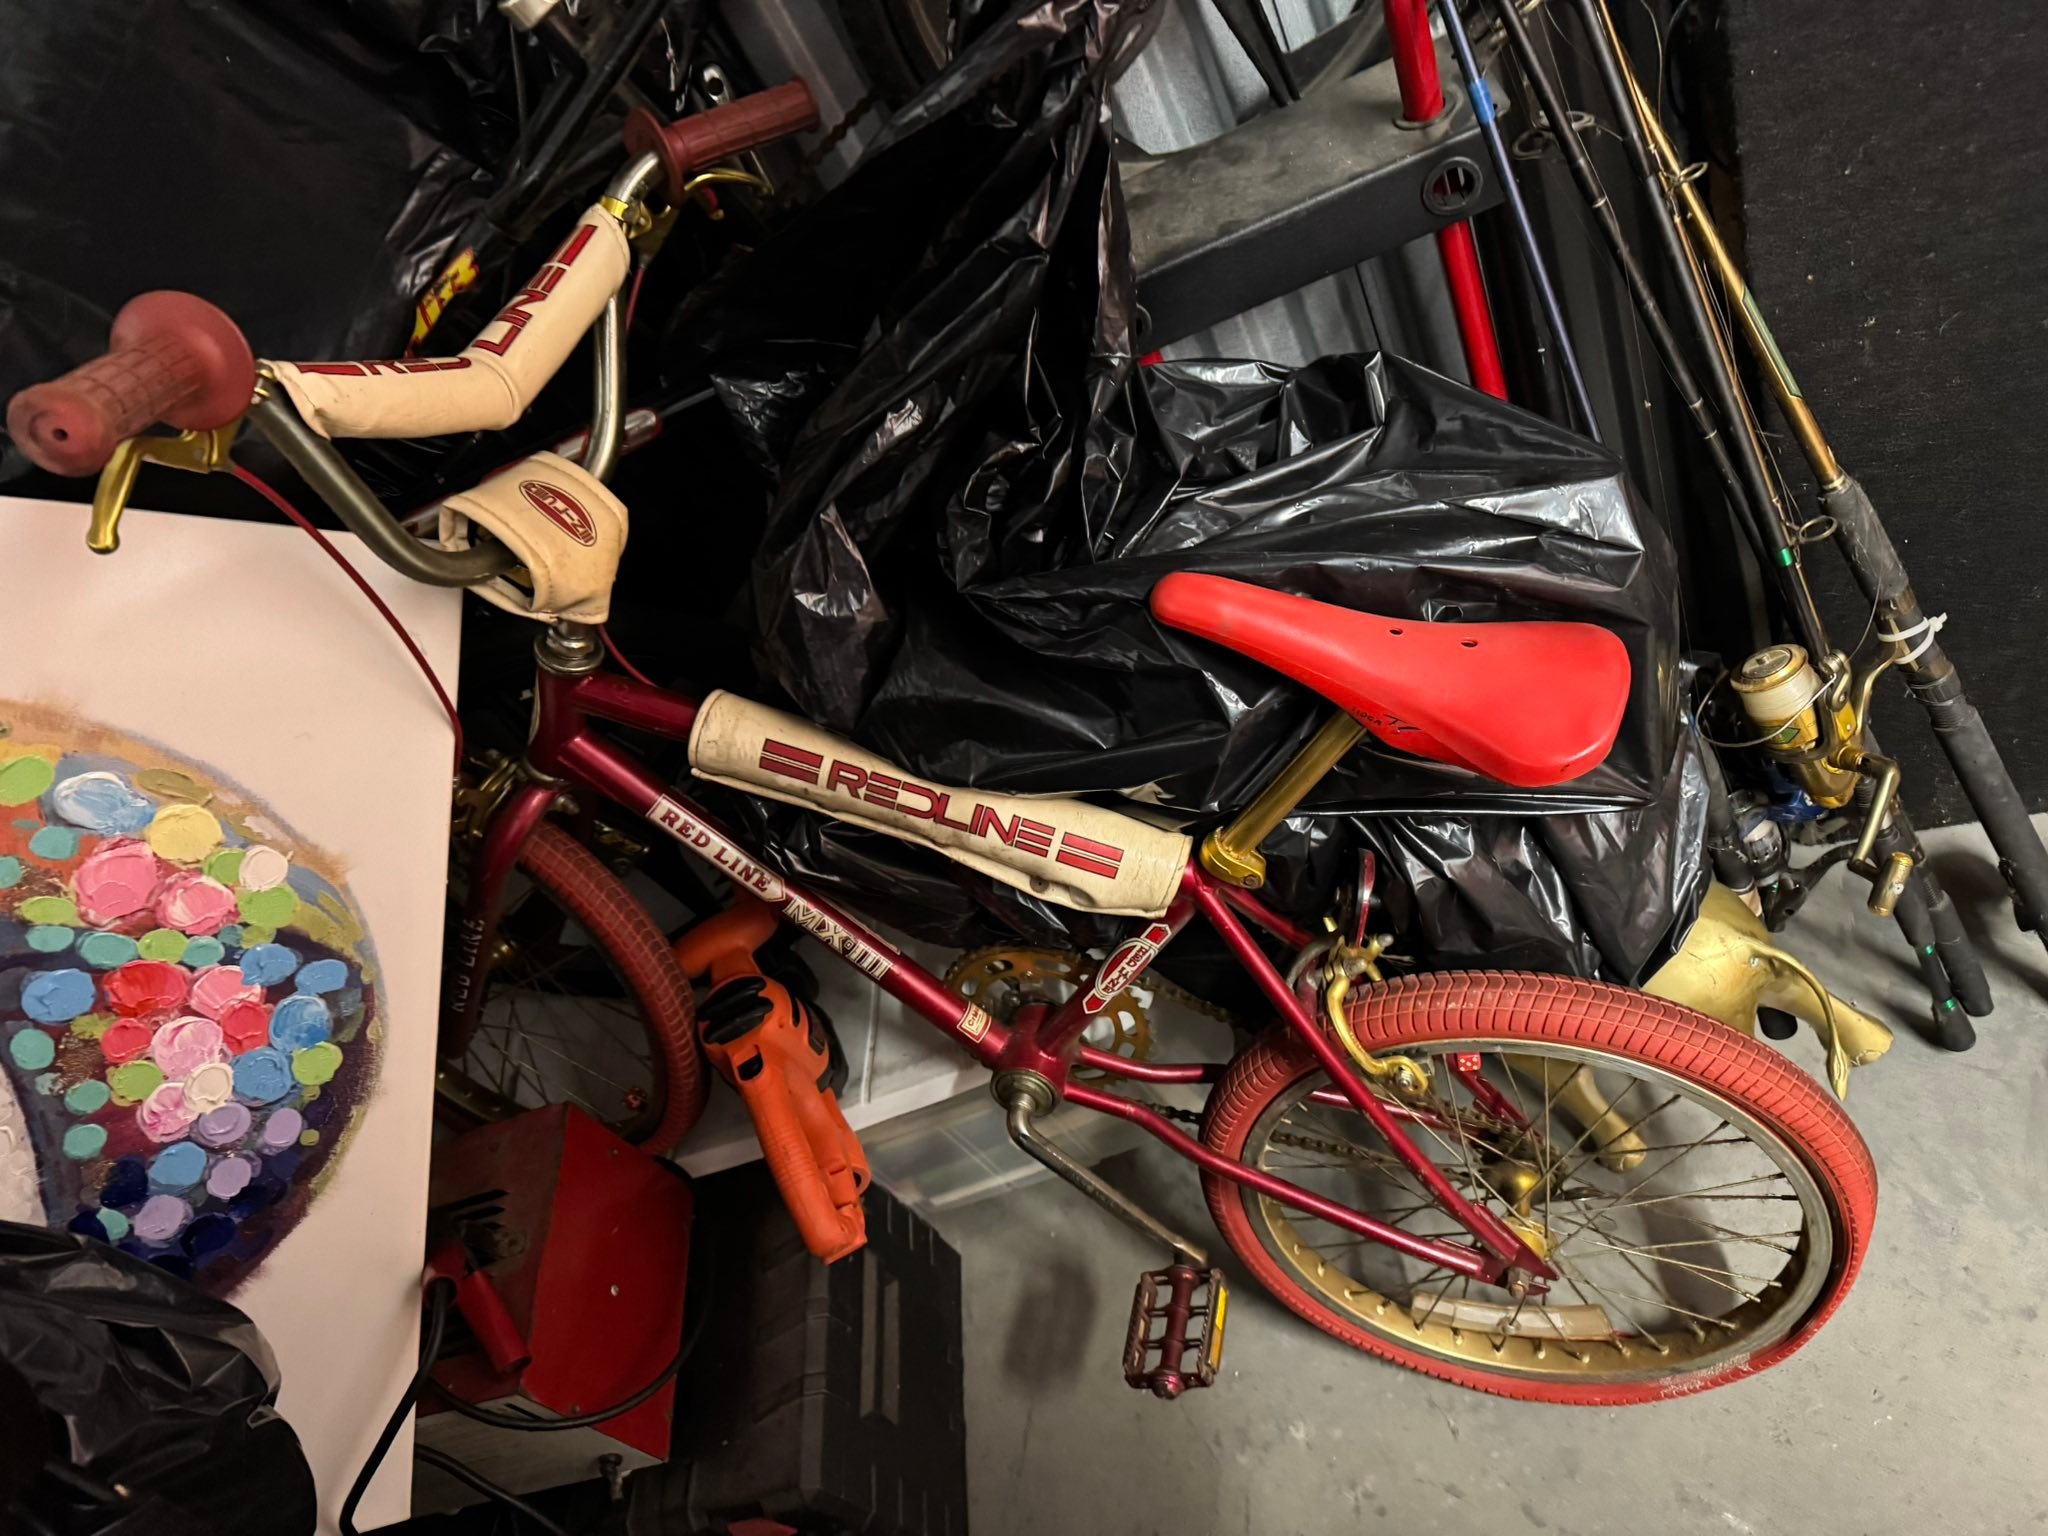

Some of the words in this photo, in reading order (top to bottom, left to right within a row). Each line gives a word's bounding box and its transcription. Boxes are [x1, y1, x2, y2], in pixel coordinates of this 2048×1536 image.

[826, 760, 1057, 858] REDLINE
[659, 807, 712, 849] RED
[713, 845, 773, 892] LINE
[1101, 965, 1130, 994] LINE
[1126, 945, 1148, 968] RED
